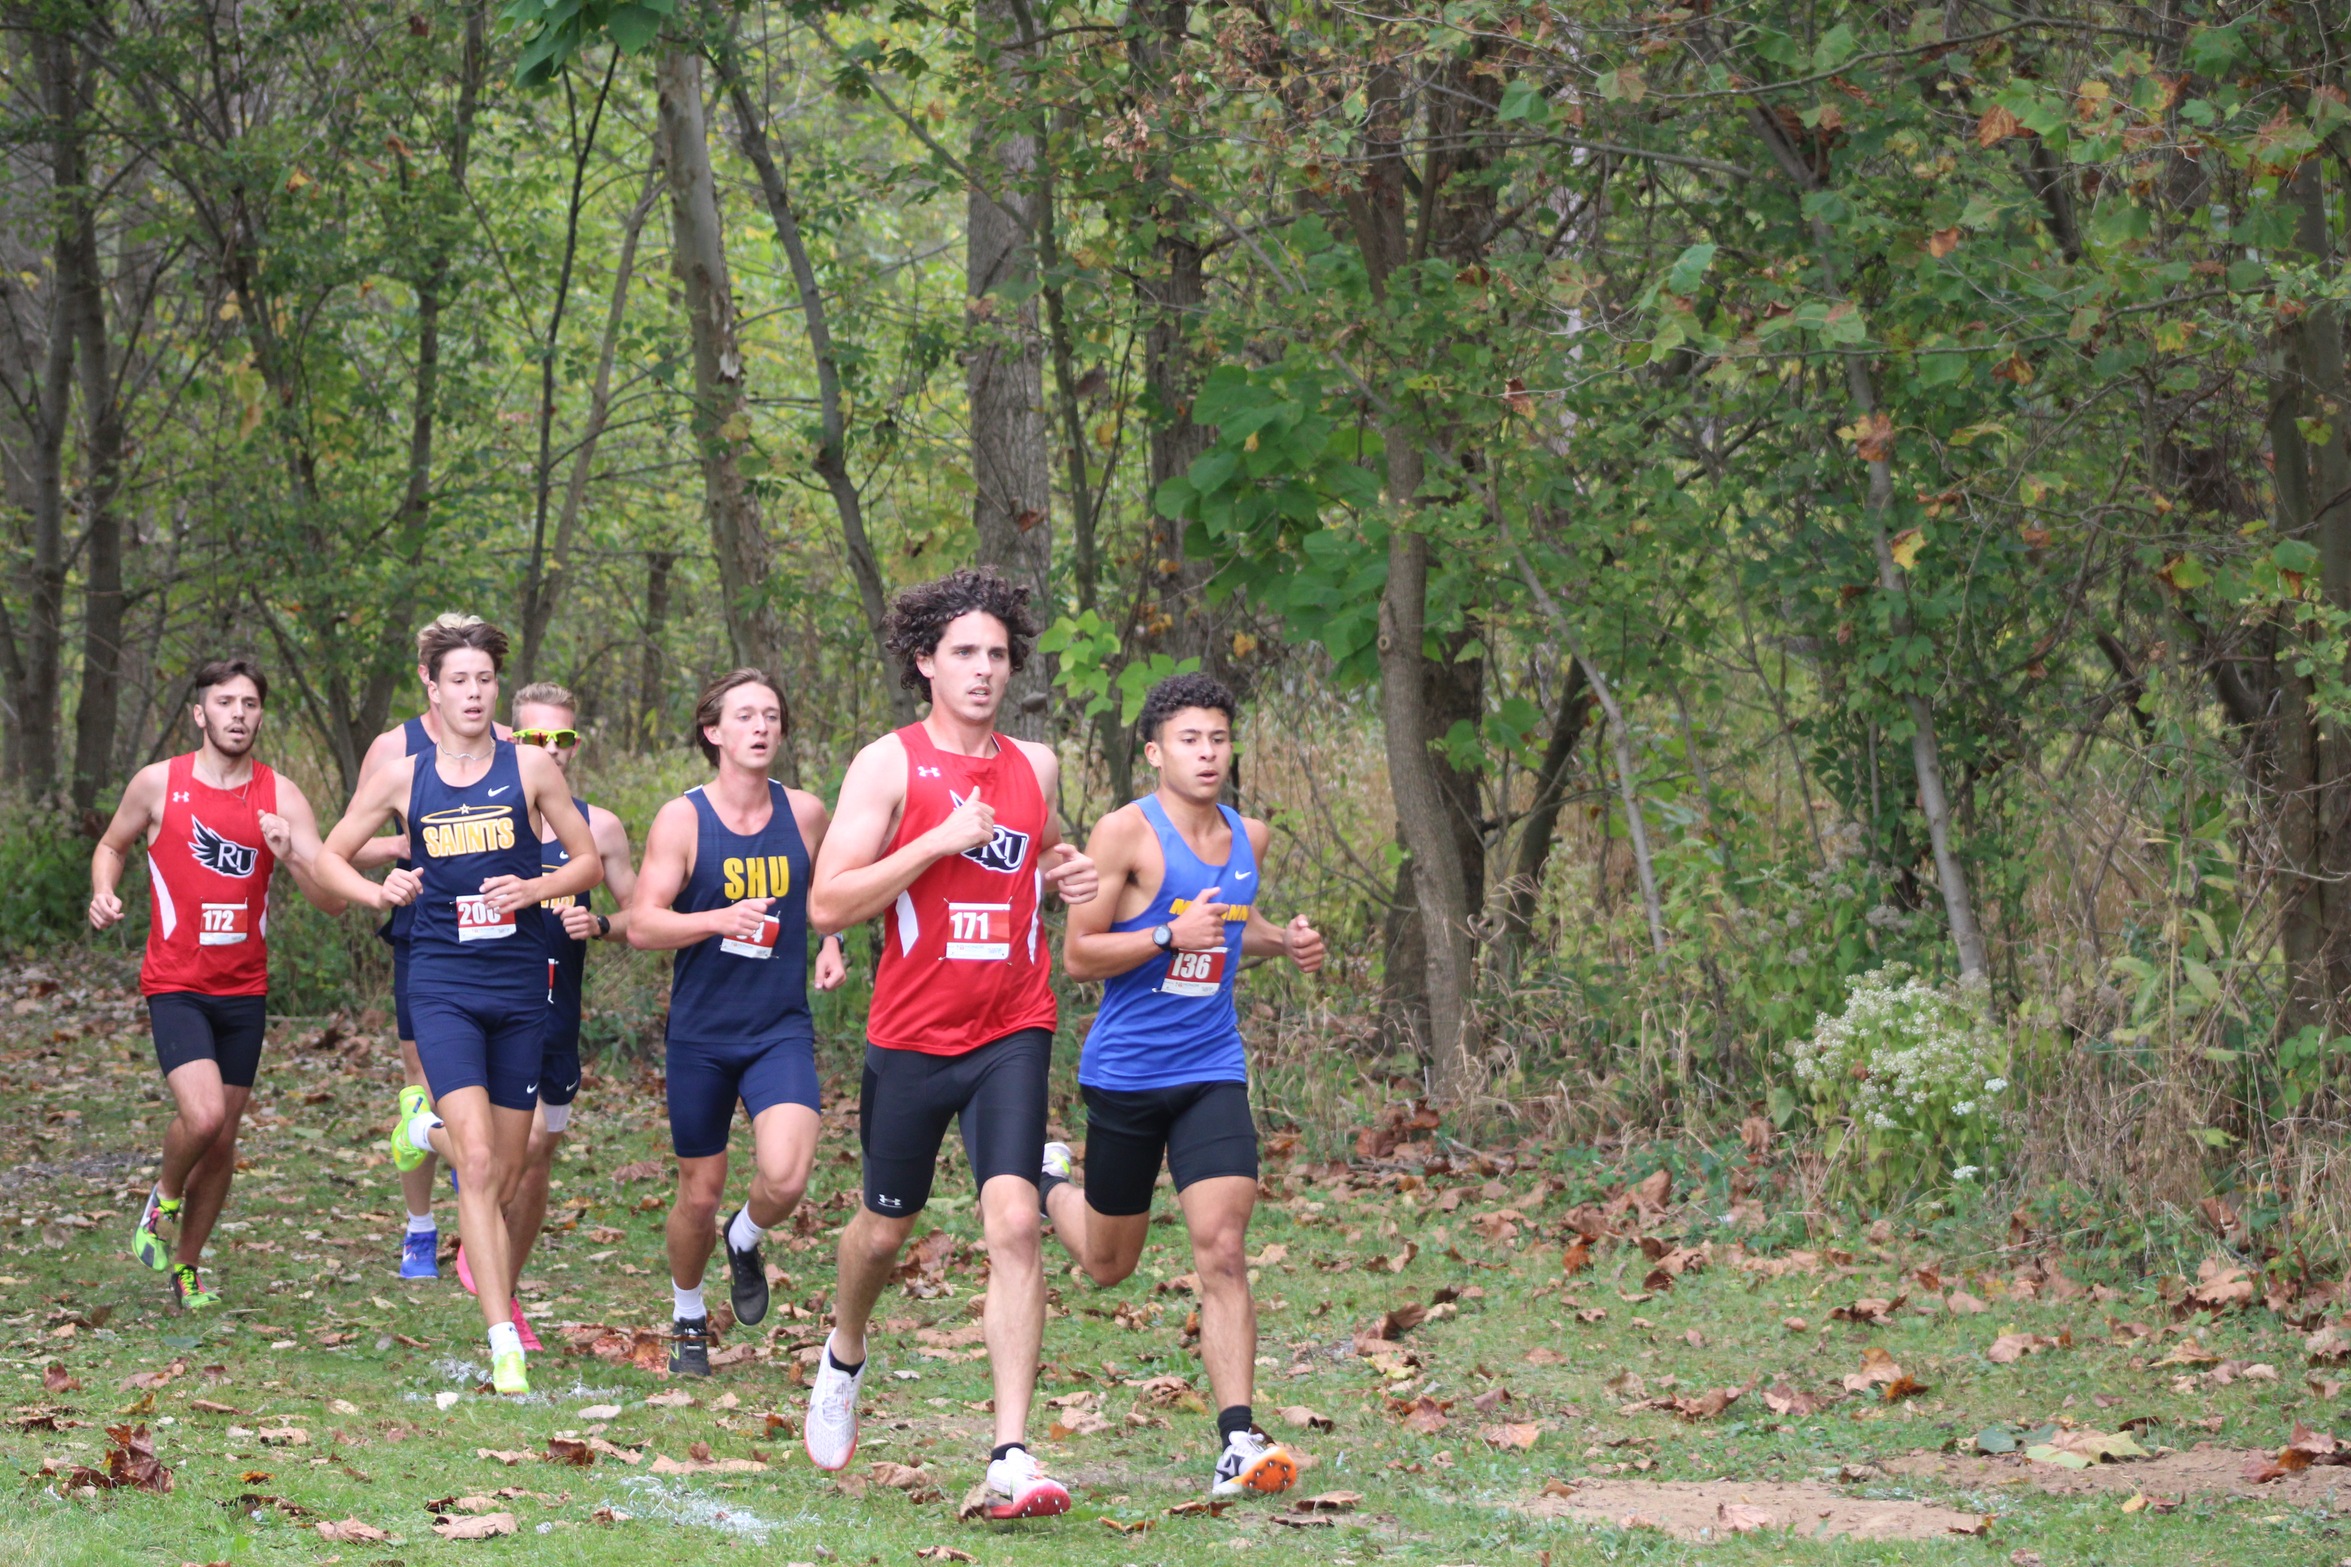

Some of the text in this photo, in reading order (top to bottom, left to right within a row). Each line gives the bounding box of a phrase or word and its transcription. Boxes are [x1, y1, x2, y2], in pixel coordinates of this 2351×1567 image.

[422, 817, 515, 858] SAINTS
[981, 828, 1027, 868] RU
[217, 842, 255, 874] RU
[723, 856, 790, 899] SHU
[203, 909, 234, 931] 172
[951, 912, 988, 939] 171
[1171, 953, 1212, 979] 136
